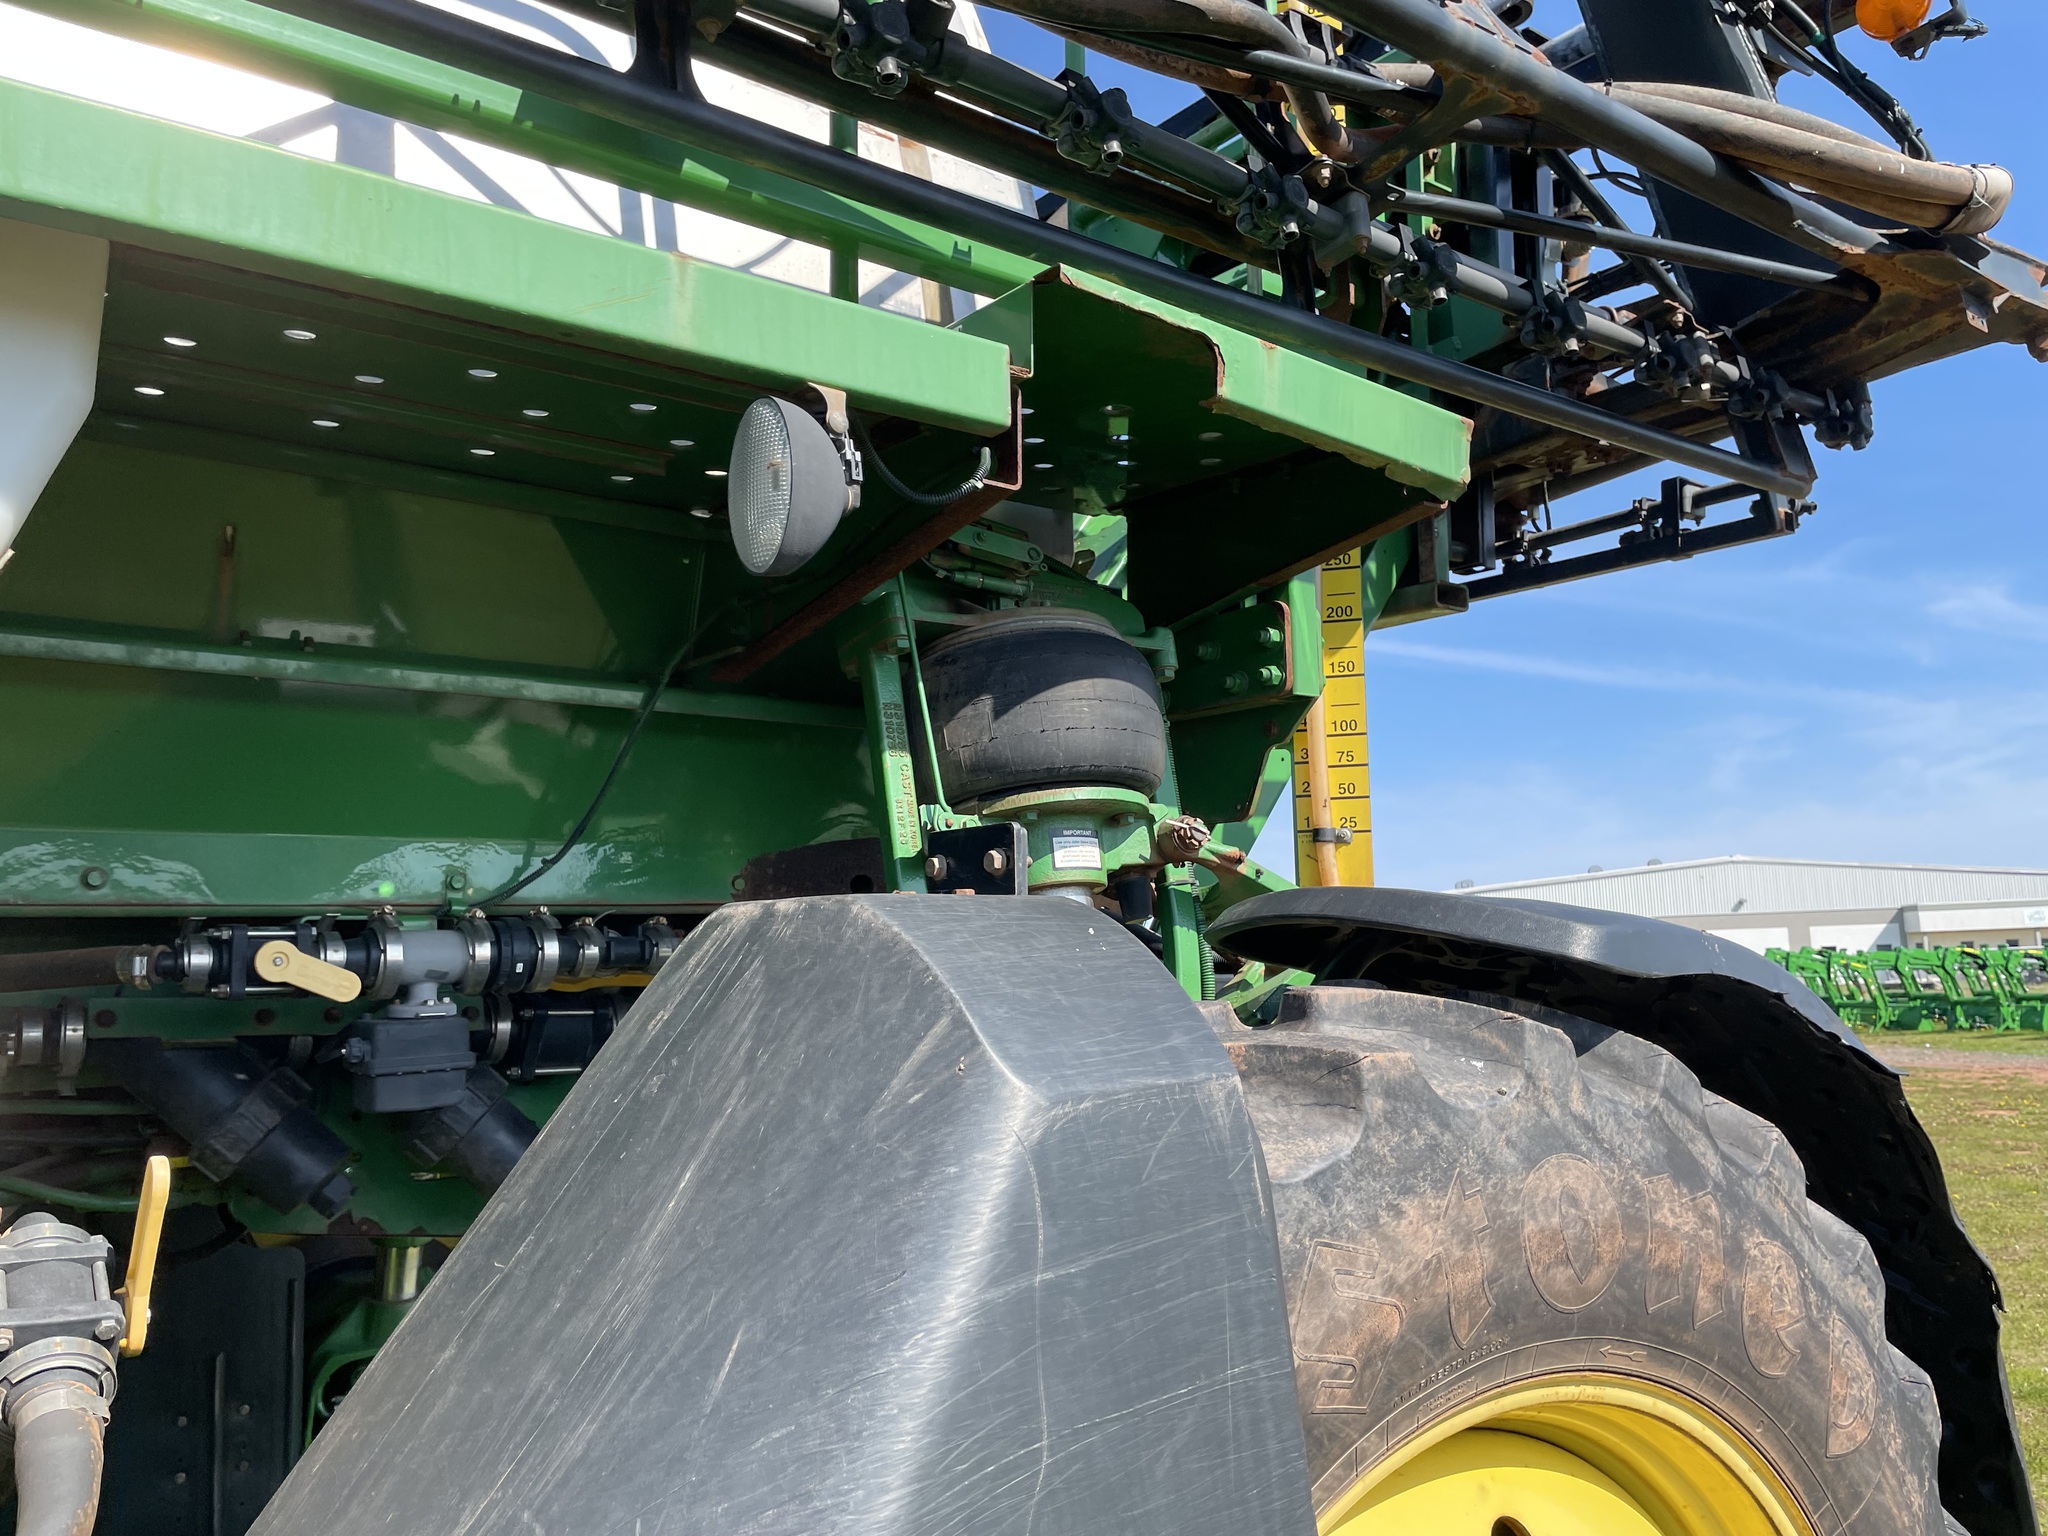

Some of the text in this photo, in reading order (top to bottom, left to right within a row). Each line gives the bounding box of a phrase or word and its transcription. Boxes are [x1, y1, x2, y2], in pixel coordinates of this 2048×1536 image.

[1326, 605, 1353, 618] 200
[1329, 660, 1355, 673] 150
[1331, 719, 1358, 732] 100
[1301, 747, 1309, 760] 3
[1336, 750, 1354, 763] 75
[900, 763, 913, 798] CAST
[1302, 781, 1310, 793] 2
[1338, 782, 1356, 795] 50
[1304, 816, 1310, 828] 1
[1339, 816, 1358, 829] 25
